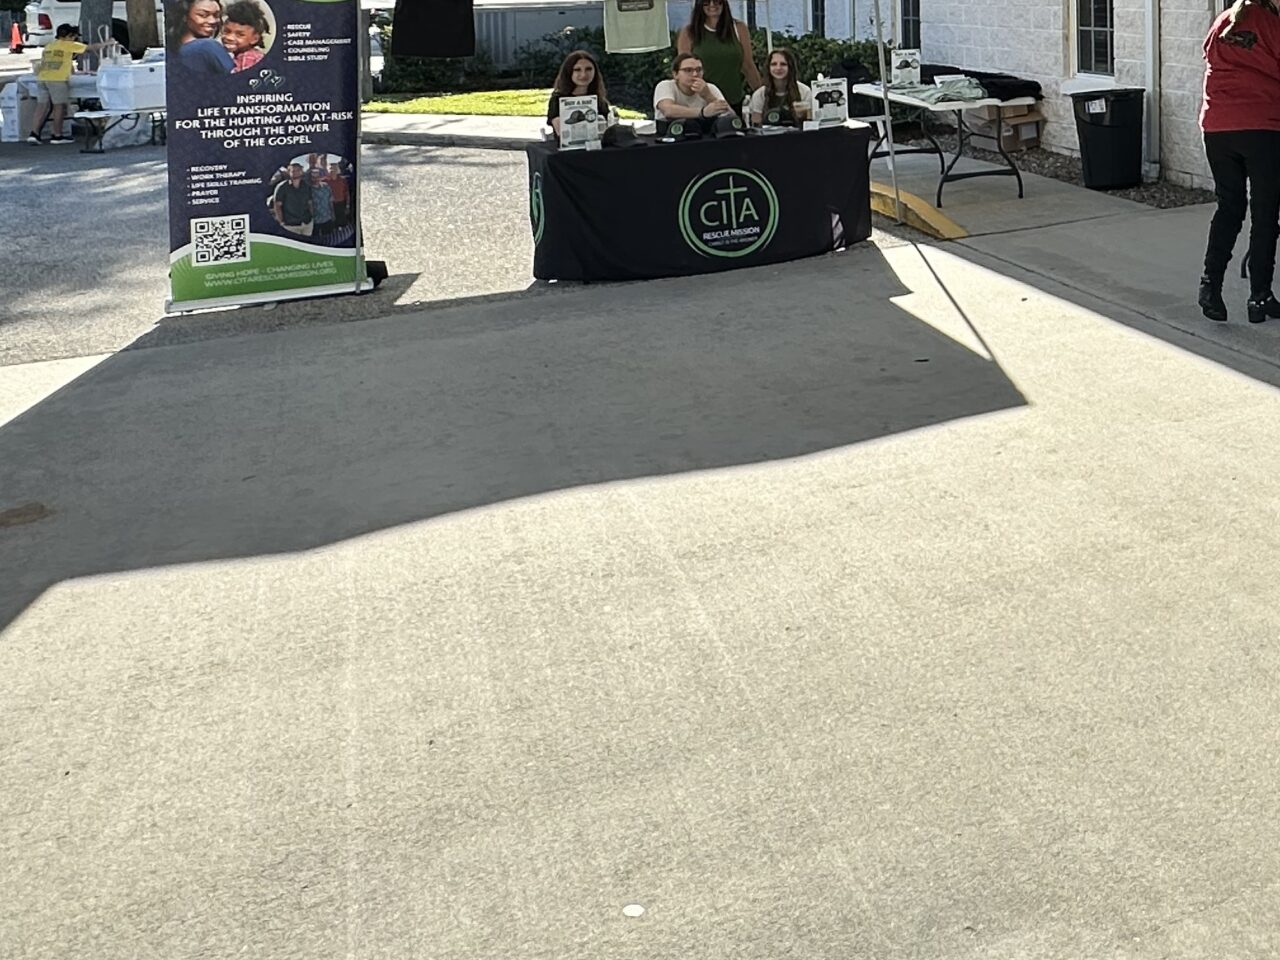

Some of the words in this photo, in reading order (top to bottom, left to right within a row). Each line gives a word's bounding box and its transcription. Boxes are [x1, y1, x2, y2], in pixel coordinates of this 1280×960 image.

[237, 93, 294, 104] INSPIRING
[198, 107, 221, 117] LIFE
[223, 102, 331, 115] TRANSFORMATION
[175, 119, 201, 129] FOR
[203, 118, 226, 128] THE
[228, 115, 282, 127] HURTING
[284, 113, 310, 123] AND
[312, 111, 353, 122] AT-RISK
[201, 127, 261, 139] THROUGH
[264, 125, 285, 135] THE
[288, 123, 330, 134] POWER
[223, 139, 241, 149] OF
[244, 137, 266, 147] THE
[268, 135, 312, 146] GOSPEL
[703, 230, 730, 240] RESCUE
[731, 226, 760, 236] MISSION
[205, 272, 235, 280] GIVING
[236, 268, 260, 277] HOPE
[266, 262, 310, 274] CHANGING
[311, 260, 334, 269] LIVES
